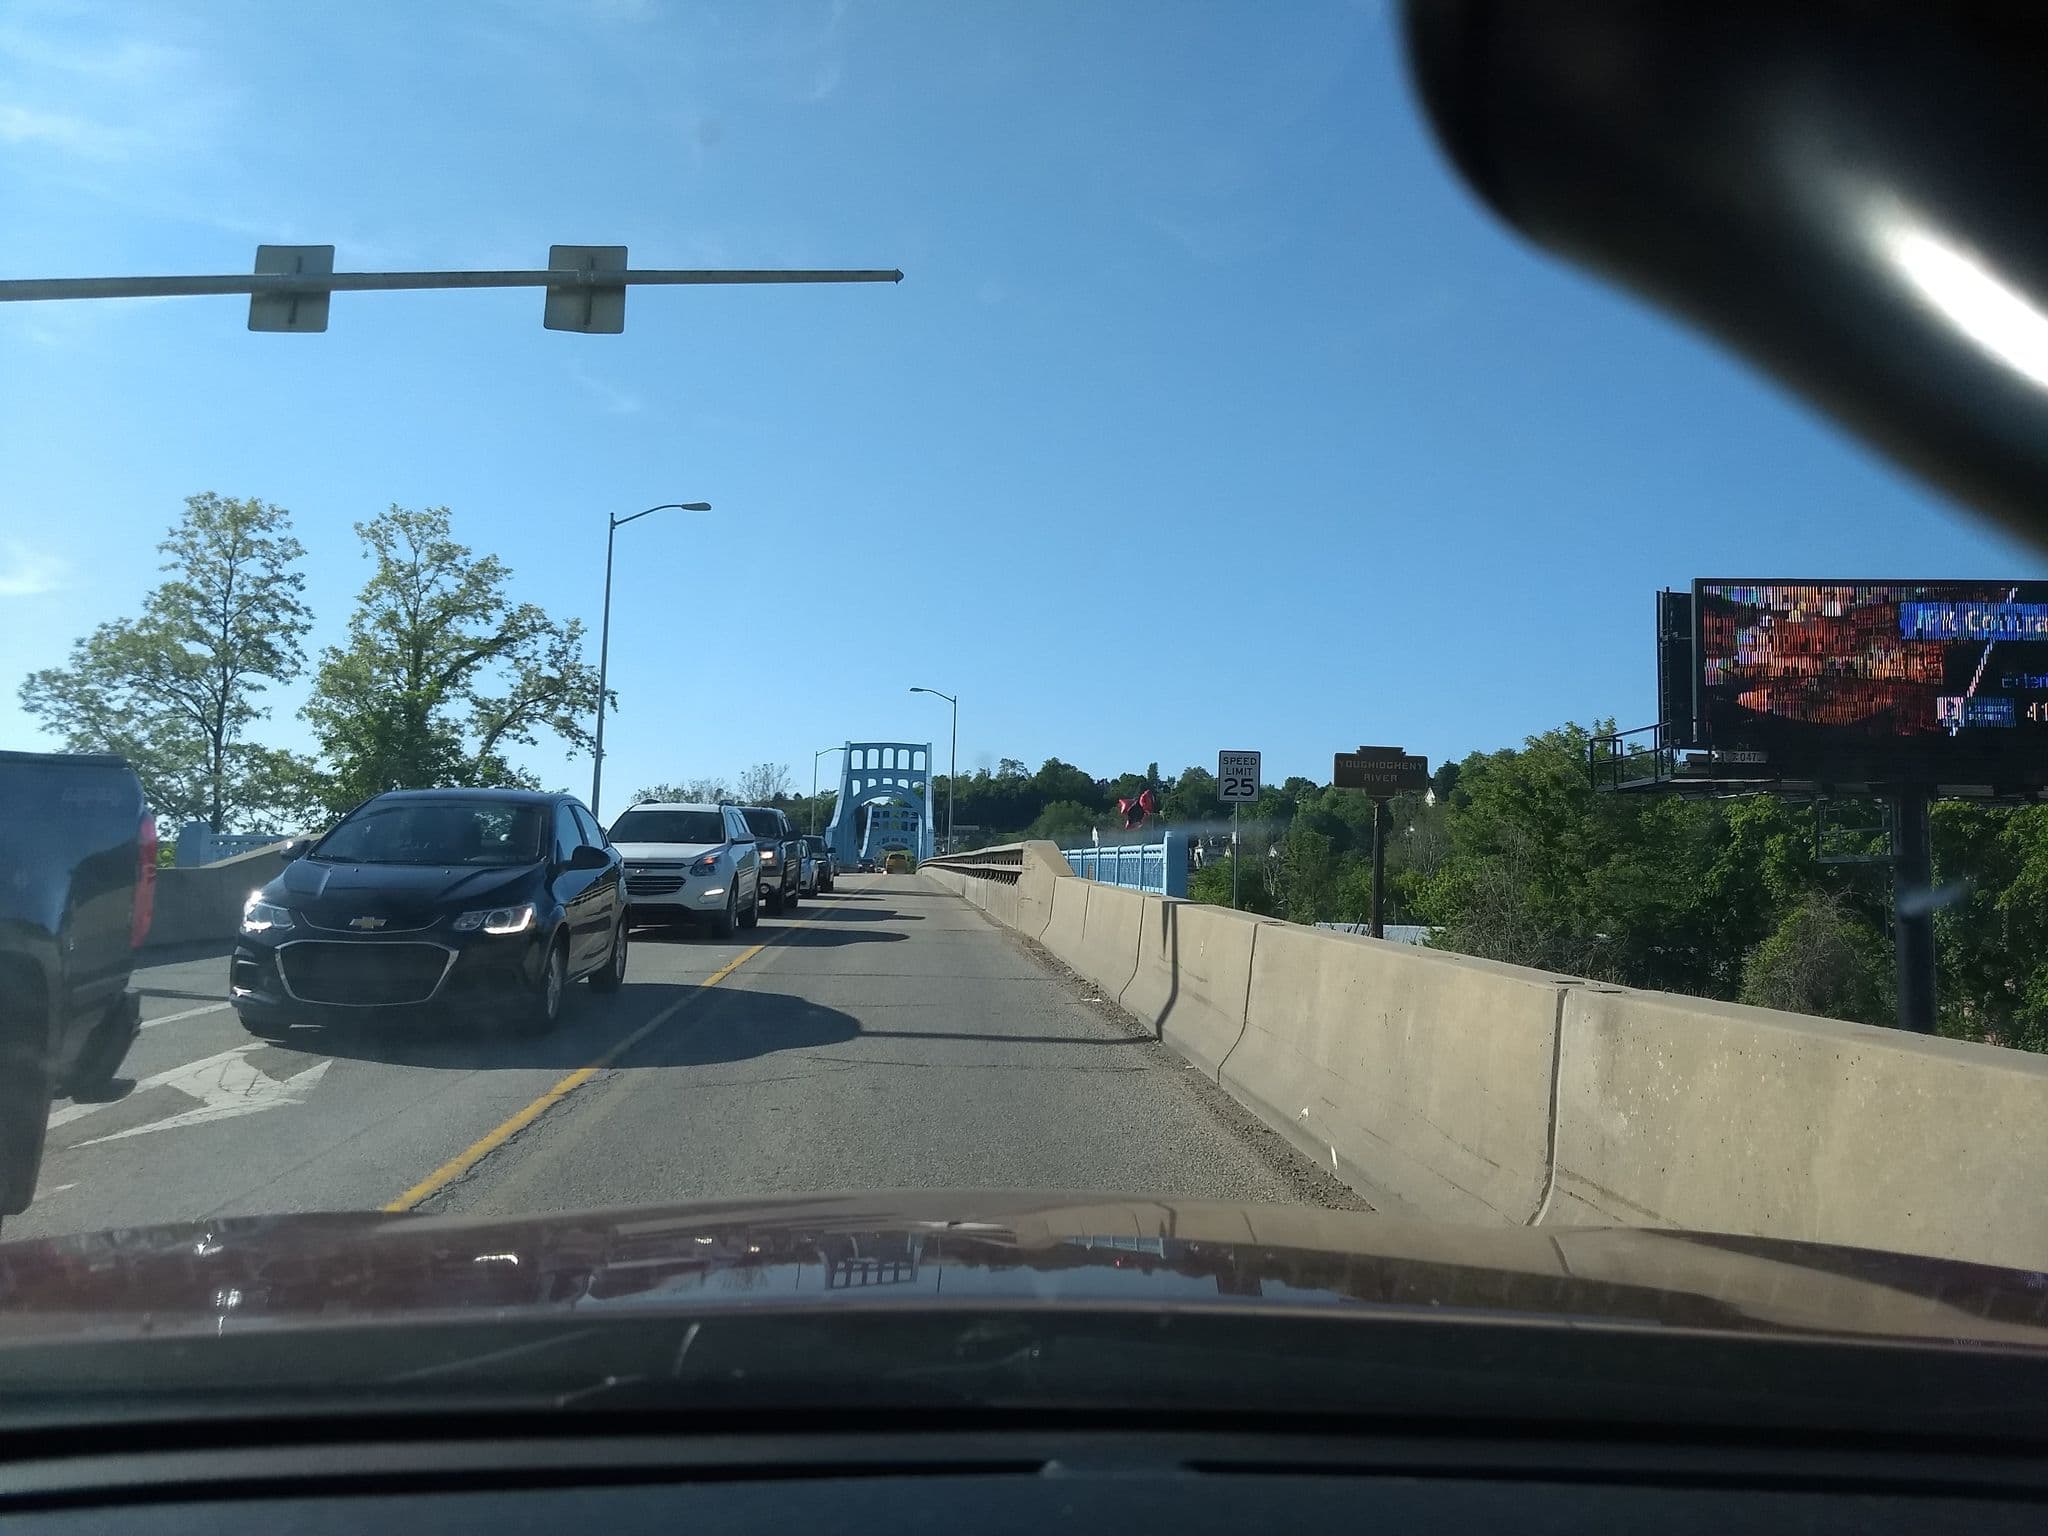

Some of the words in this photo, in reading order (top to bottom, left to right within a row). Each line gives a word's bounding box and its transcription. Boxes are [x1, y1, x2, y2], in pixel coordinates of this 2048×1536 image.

[1223, 757, 1257, 766] SPEED
[1225, 767, 1253, 776] LIMIT
[1363, 773, 1398, 782] RIVER
[1223, 777, 1255, 796] 25
